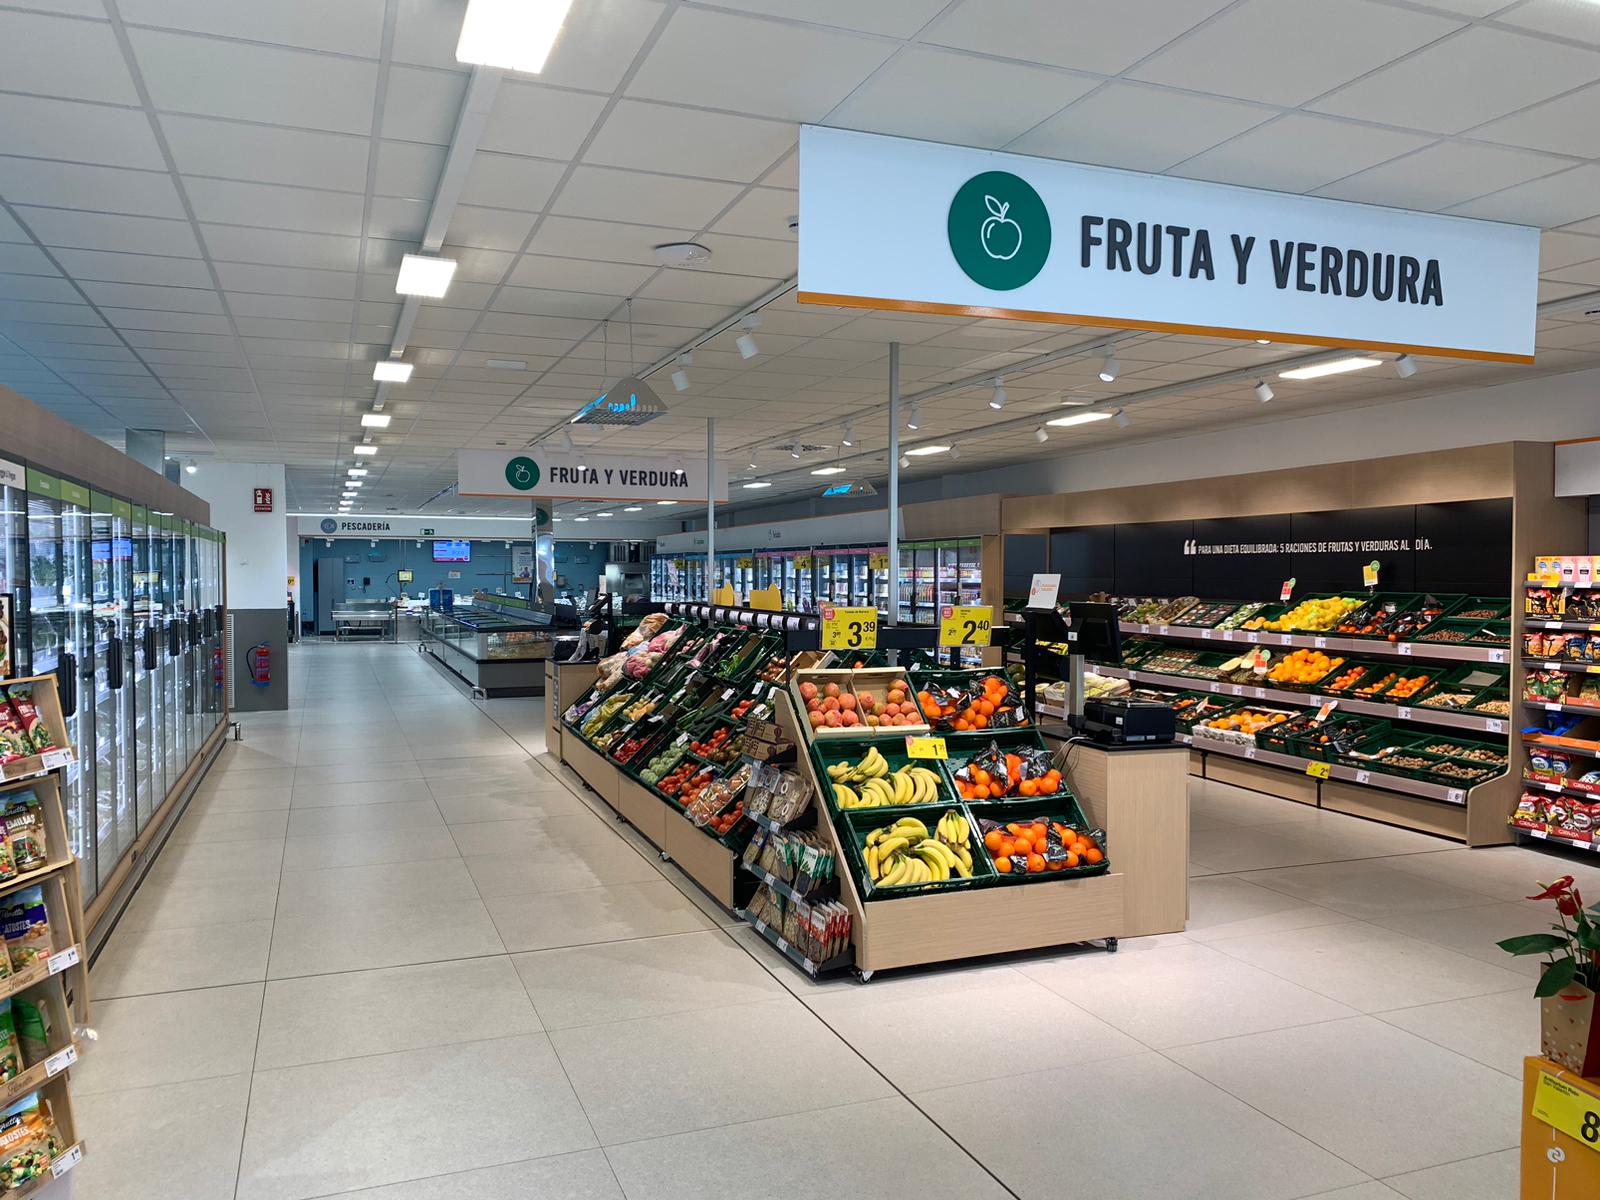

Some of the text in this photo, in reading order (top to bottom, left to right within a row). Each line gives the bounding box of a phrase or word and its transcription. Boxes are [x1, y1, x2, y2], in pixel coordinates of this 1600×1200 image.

[1081, 215, 1444, 307] FRUTA Y VERDURA
[550, 466, 689, 488] FRUTA Y VERDURA
[341, 521, 391, 531] PESCADERÍA
[1198, 545, 1212, 554] PARA
[1212, 545, 1223, 554] UNA
[1224, 544, 1240, 554] DIETA
[1280, 543, 1284, 553] 5
[1285, 542, 1317, 553] RACIONES
[1318, 542, 1327, 552] DE
[1328, 541, 1354, 552] FRUTAS
[1354, 541, 1360, 552] Y
[1361, 540, 1399, 551] VERDURAS
[1400, 539, 1410, 551] AL
[848, 622, 862, 647] 3
[962, 620, 977, 644] 2
[5, 814, 36, 830] EMILLAS
[1580, 1110, 1600, 1143] 8
